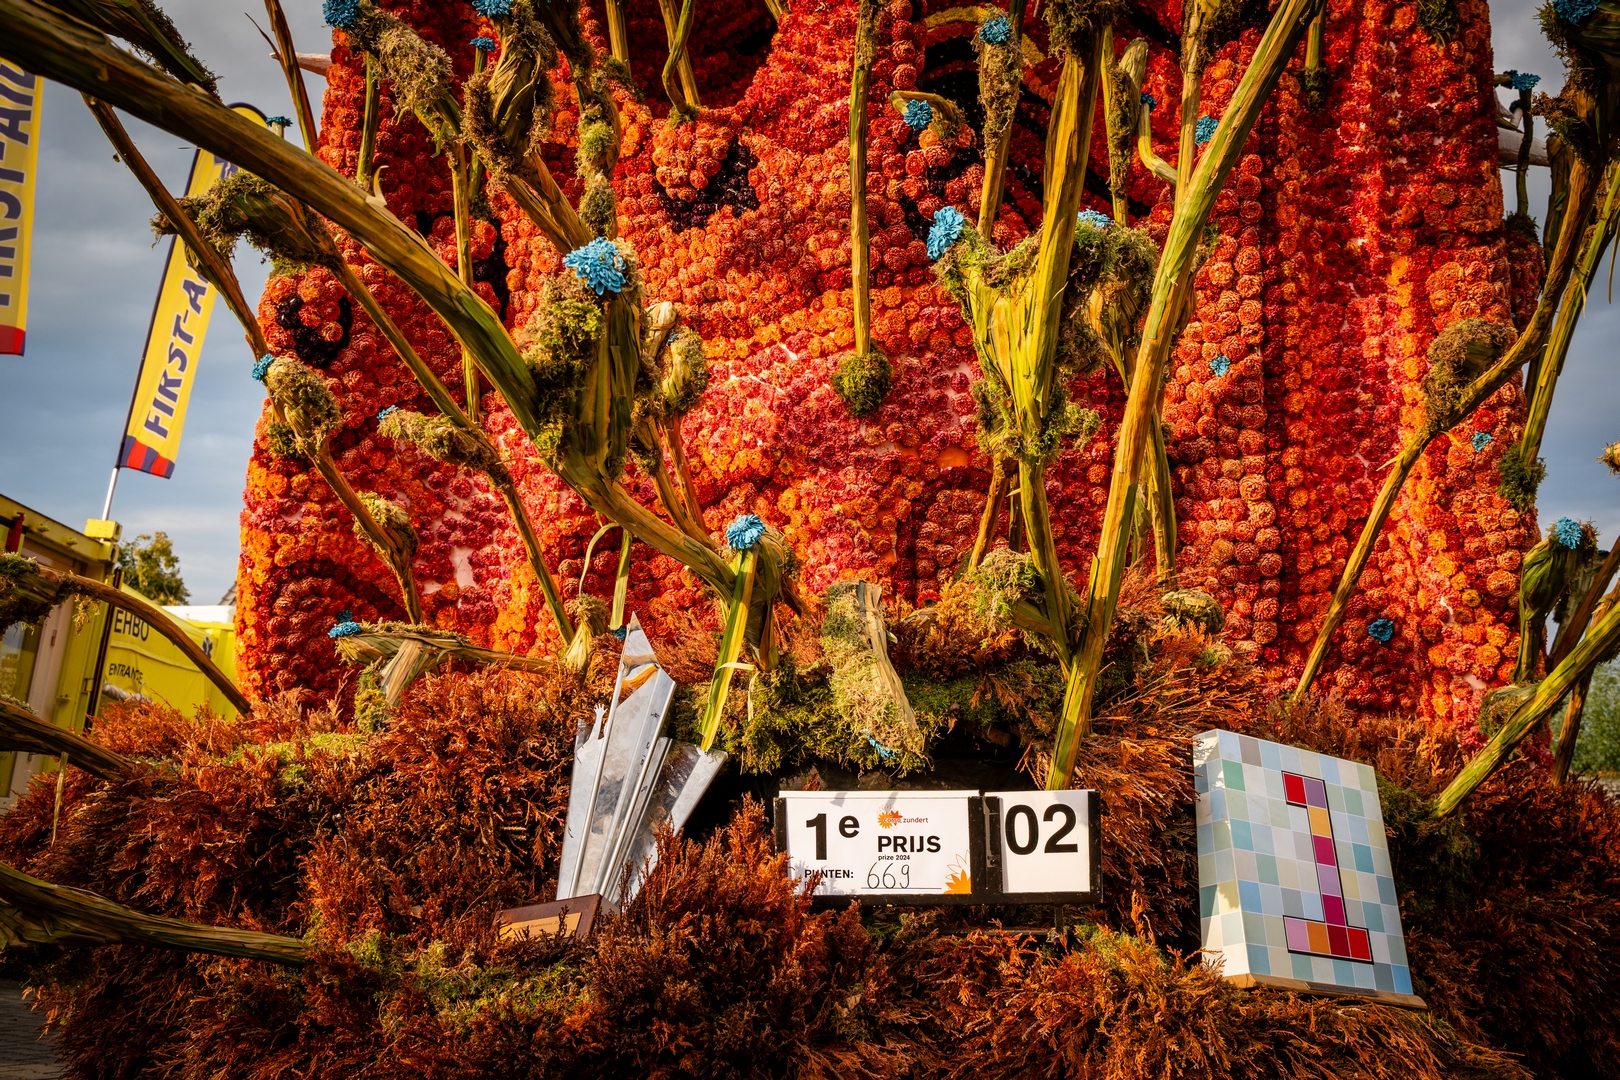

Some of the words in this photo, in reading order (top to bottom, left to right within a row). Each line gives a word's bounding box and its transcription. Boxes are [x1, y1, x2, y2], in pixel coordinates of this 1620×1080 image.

[143, 262, 211, 440] FIRST-A
[113, 609, 150, 642] EHBO
[108, 663, 144, 685] ENTRANCE
[903, 816, 929, 824] zundert
[1004, 803, 1079, 856] 02
[877, 835, 941, 853] PRIJS
[867, 861, 910, 890] 669
